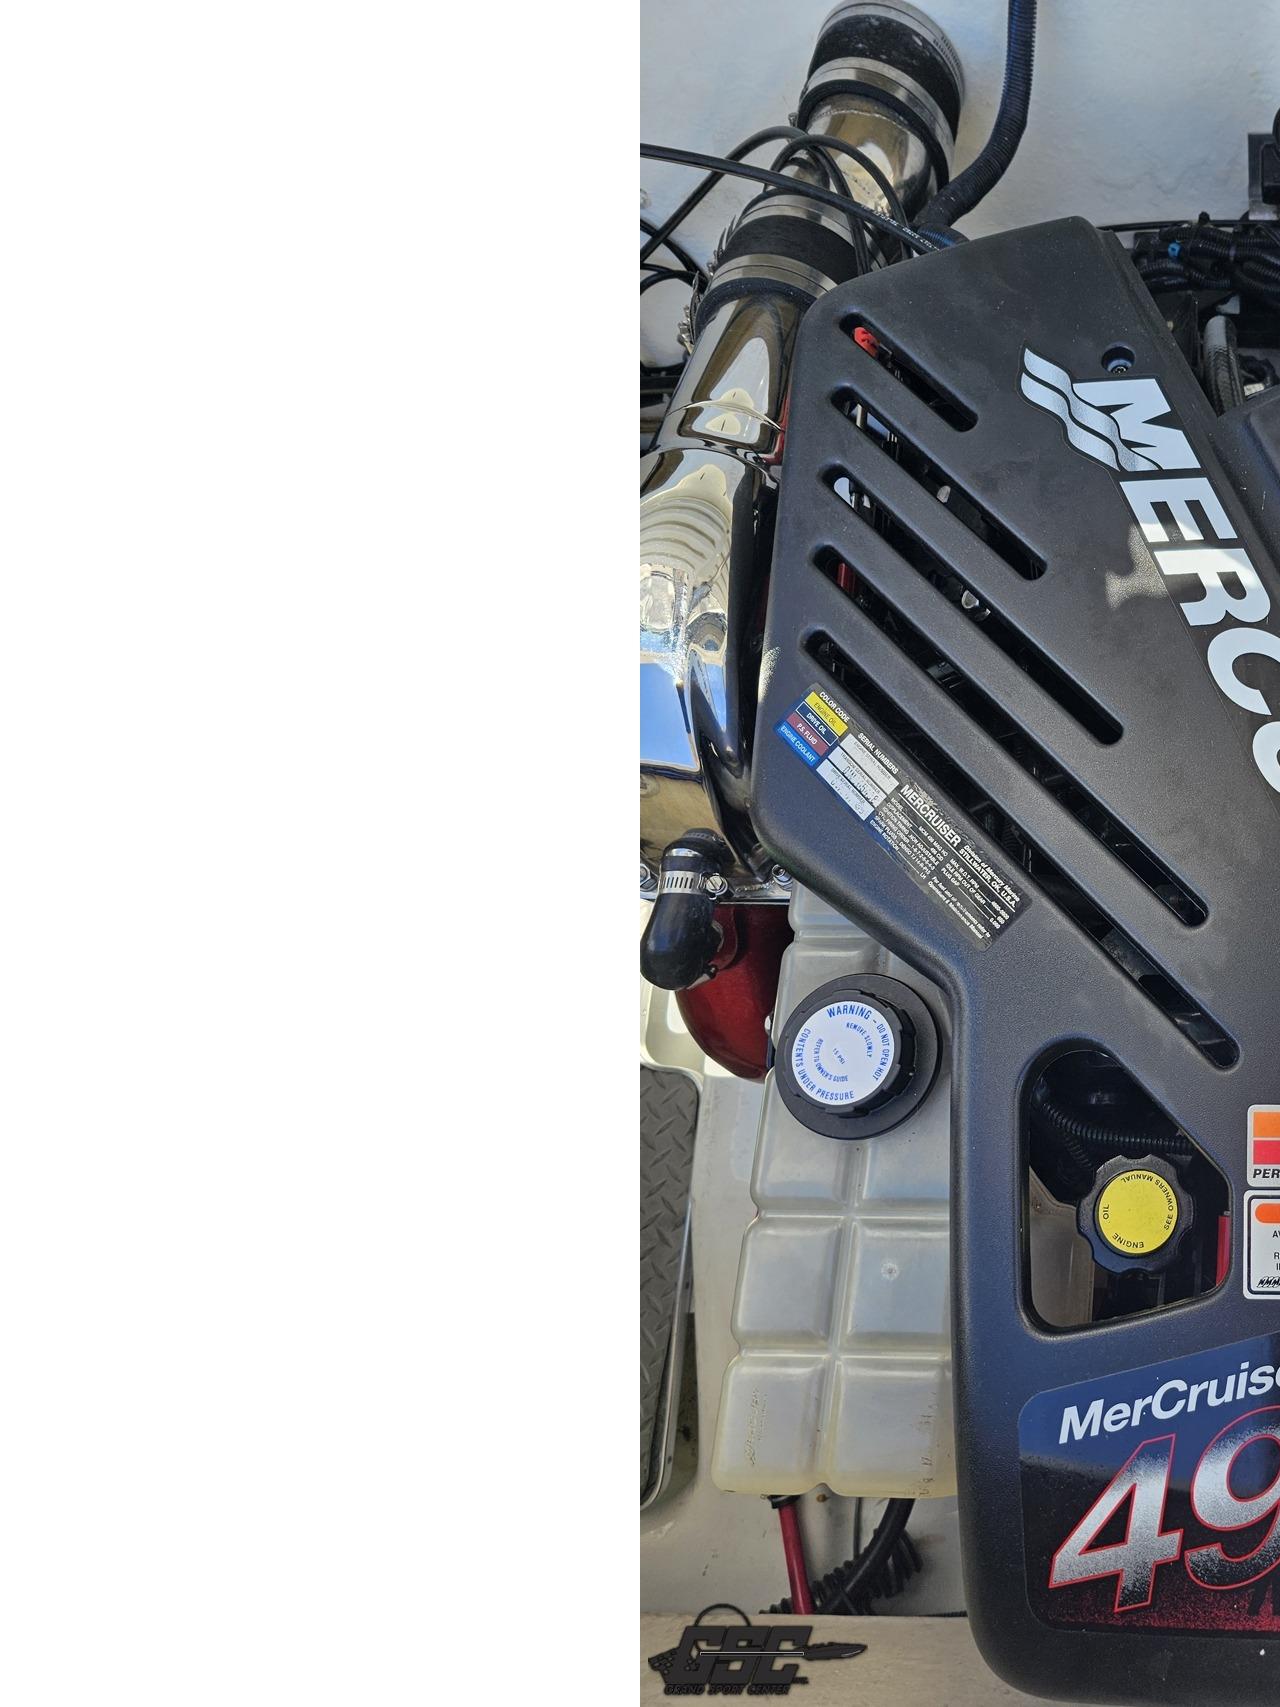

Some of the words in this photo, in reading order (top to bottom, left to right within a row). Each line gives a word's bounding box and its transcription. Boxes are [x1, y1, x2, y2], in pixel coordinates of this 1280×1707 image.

[813, 702, 830, 719] ENGINE
[828, 717, 837, 726] OIL
[819, 691, 836, 709] COLOR
[834, 707, 849, 722] CODE
[796, 722, 806, 733] P.S.
[803, 730, 817, 745] FLUID
[806, 712, 820, 726] DRIVE
[818, 724, 827, 734] OIL
[780, 725, 796, 742] ENGINE
[794, 740, 815, 762] COOLANT
[857, 732, 876, 751] SERIAL
[873, 748, 898, 774] NUMBERS
[899, 783, 962, 847] MERCRUISER
[916, 842, 939, 865] ADJUSTABLE
[958, 847, 992, 882] STILLWATER,
[1000, 890, 1017, 907] U.S.A.
[963, 844, 982, 863] Division
[985, 866, 1005, 886] Mercury
[1003, 884, 1020, 901] Marine
[961, 879, 970, 888] OUT
[974, 892, 986, 904] GEAR
[827, 1005, 872, 1020] WARNING
[846, 1022, 867, 1036] REMOVE
[864, 1035, 873, 1058] SLOWLY
[877, 1024, 886, 1033] DO
[881, 1034, 890, 1046] NOT
[795, 1028, 811, 1068] CONTENTS
[880, 1049, 890, 1067] OPEN
[798, 1069, 816, 1092] UNDER
[873, 1067, 885, 1081] HOT
[816, 1088, 855, 1101] PRESSURE
[1121, 1174, 1154, 1183] MANUAL
[1155, 1179, 1174, 1211] OWNERS
[1164, 1214, 1173, 1230] SEE
[1112, 1233, 1145, 1249] ENGINE
